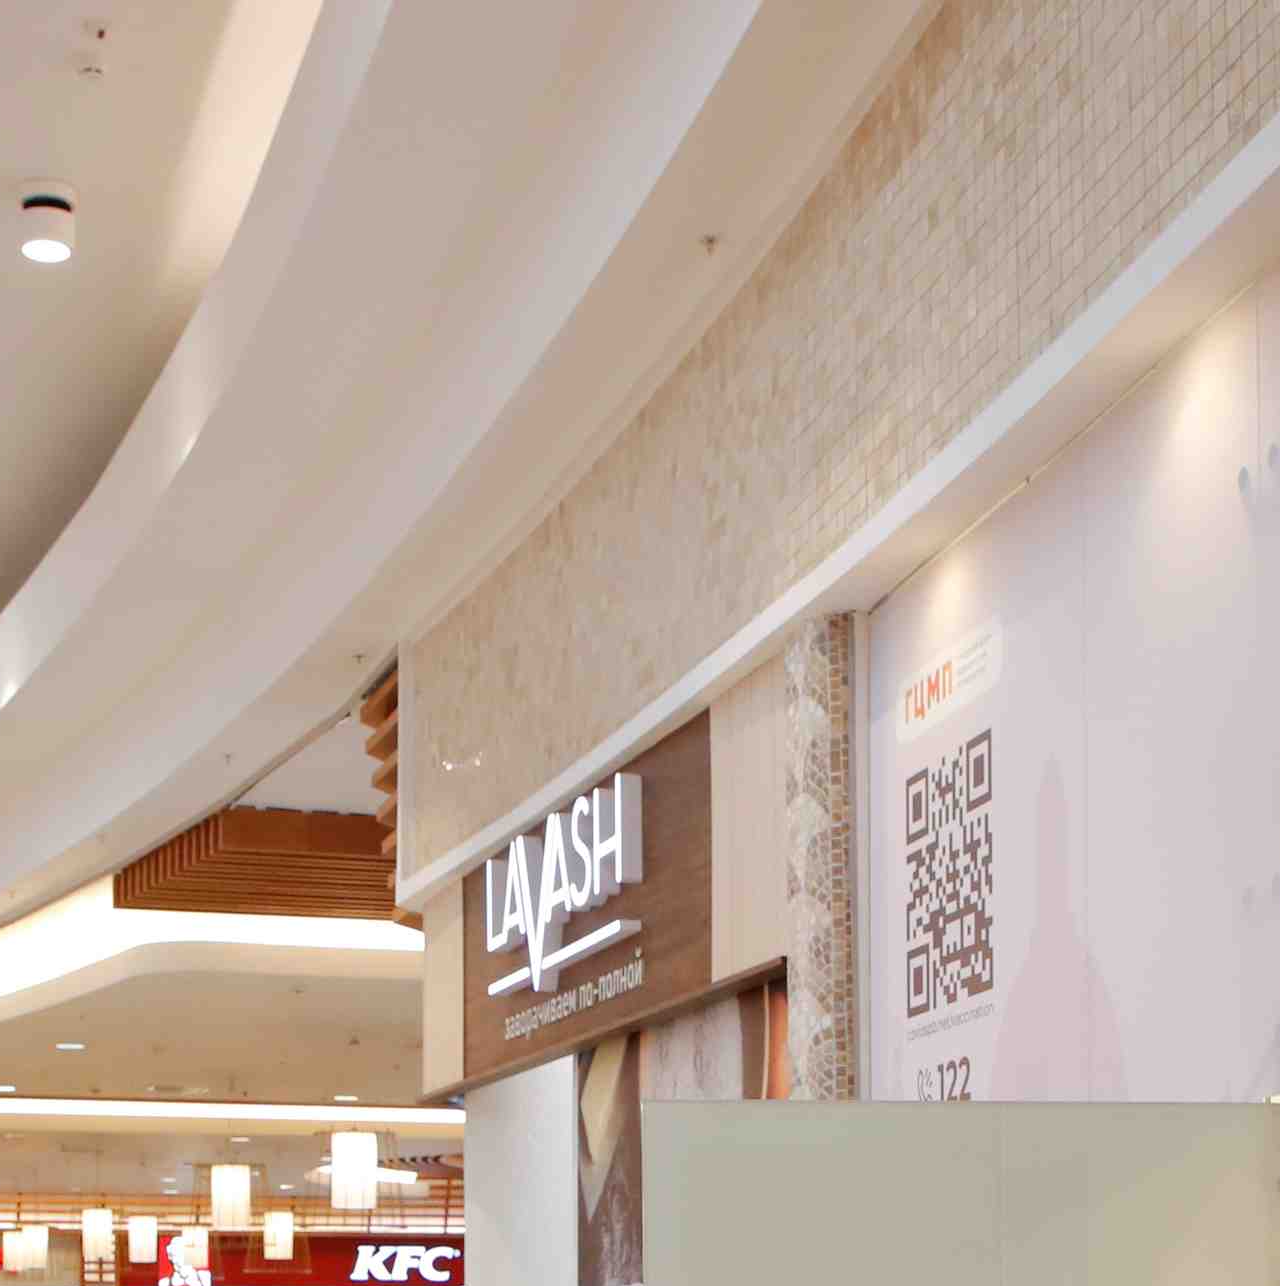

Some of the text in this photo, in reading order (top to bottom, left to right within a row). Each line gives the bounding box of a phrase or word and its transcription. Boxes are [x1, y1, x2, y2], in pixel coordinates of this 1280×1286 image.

[904, 660, 953, 725] ГЦМП
[485, 772, 623, 992] LAVASH
[578, 944, 644, 1009] по-полной
[937, 1056, 971, 1102] 122
[349, 1244, 453, 1282] KFC
